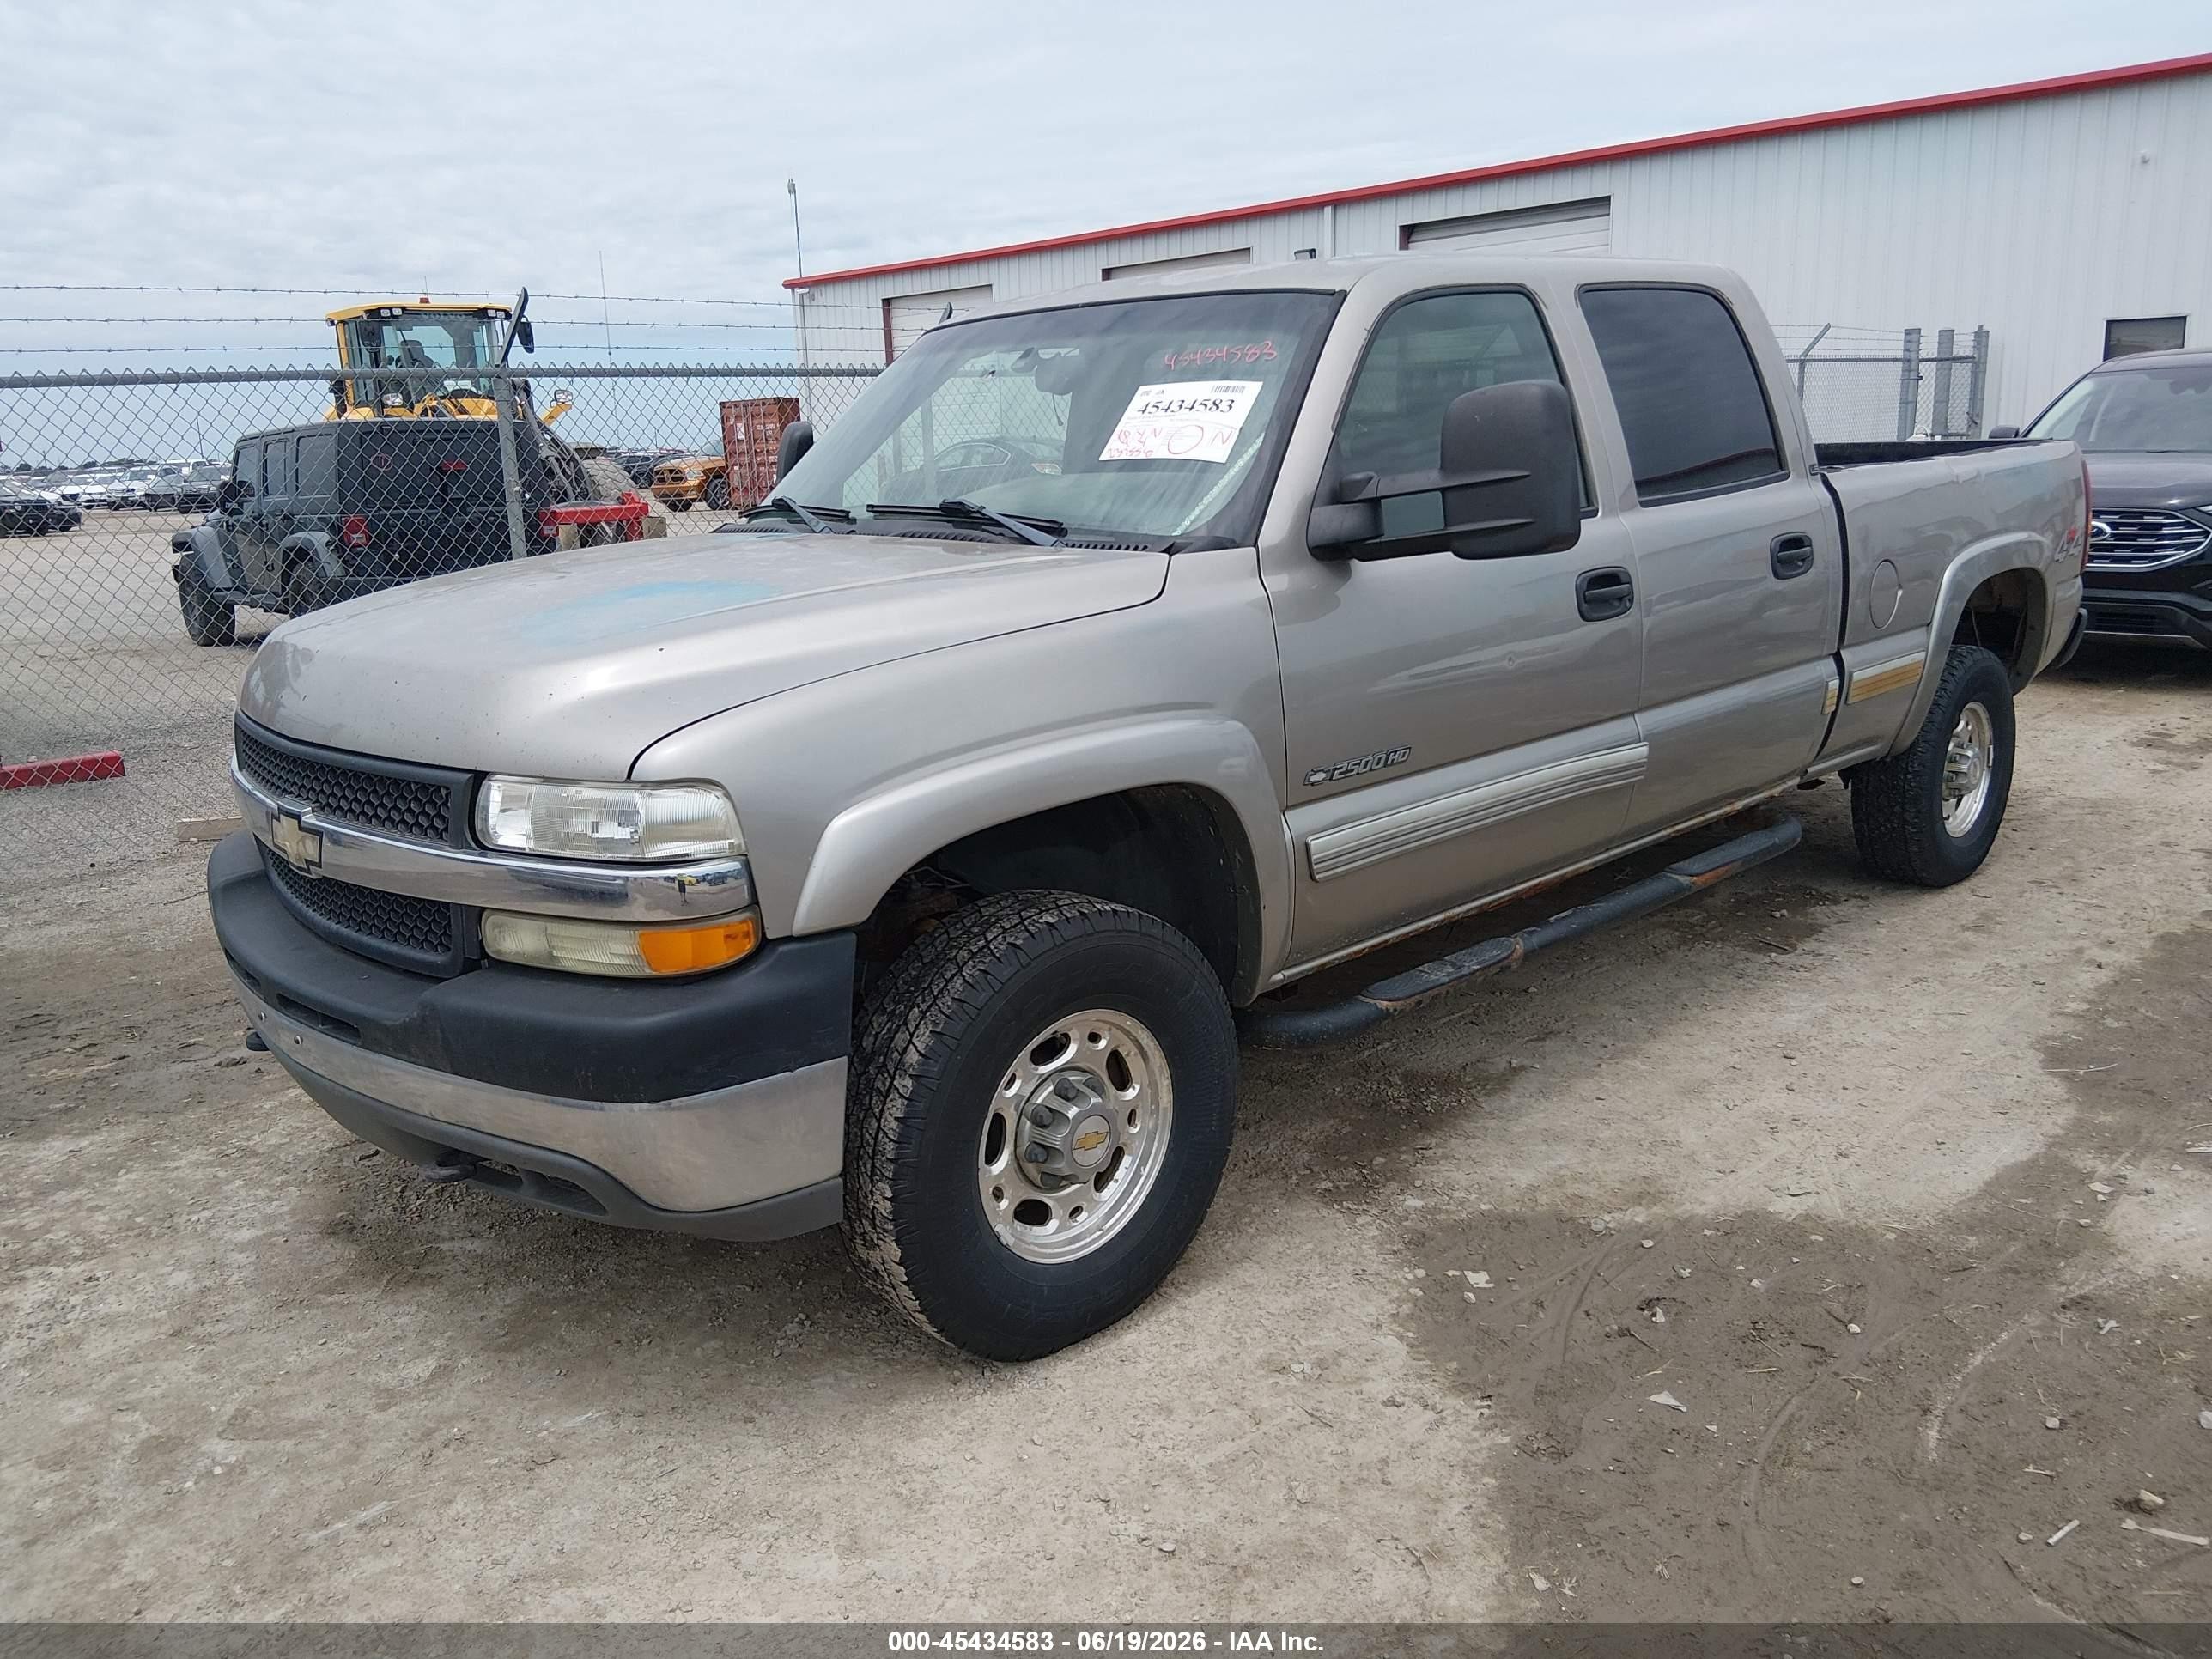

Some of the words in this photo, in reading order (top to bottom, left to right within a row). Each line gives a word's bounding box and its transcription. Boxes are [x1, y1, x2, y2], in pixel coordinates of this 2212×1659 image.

[1164, 340, 1278, 370] 45434583
[1137, 398, 1236, 415] 45434583
[1332, 753, 1387, 781] 2500
[1387, 748, 1411, 765] HD
